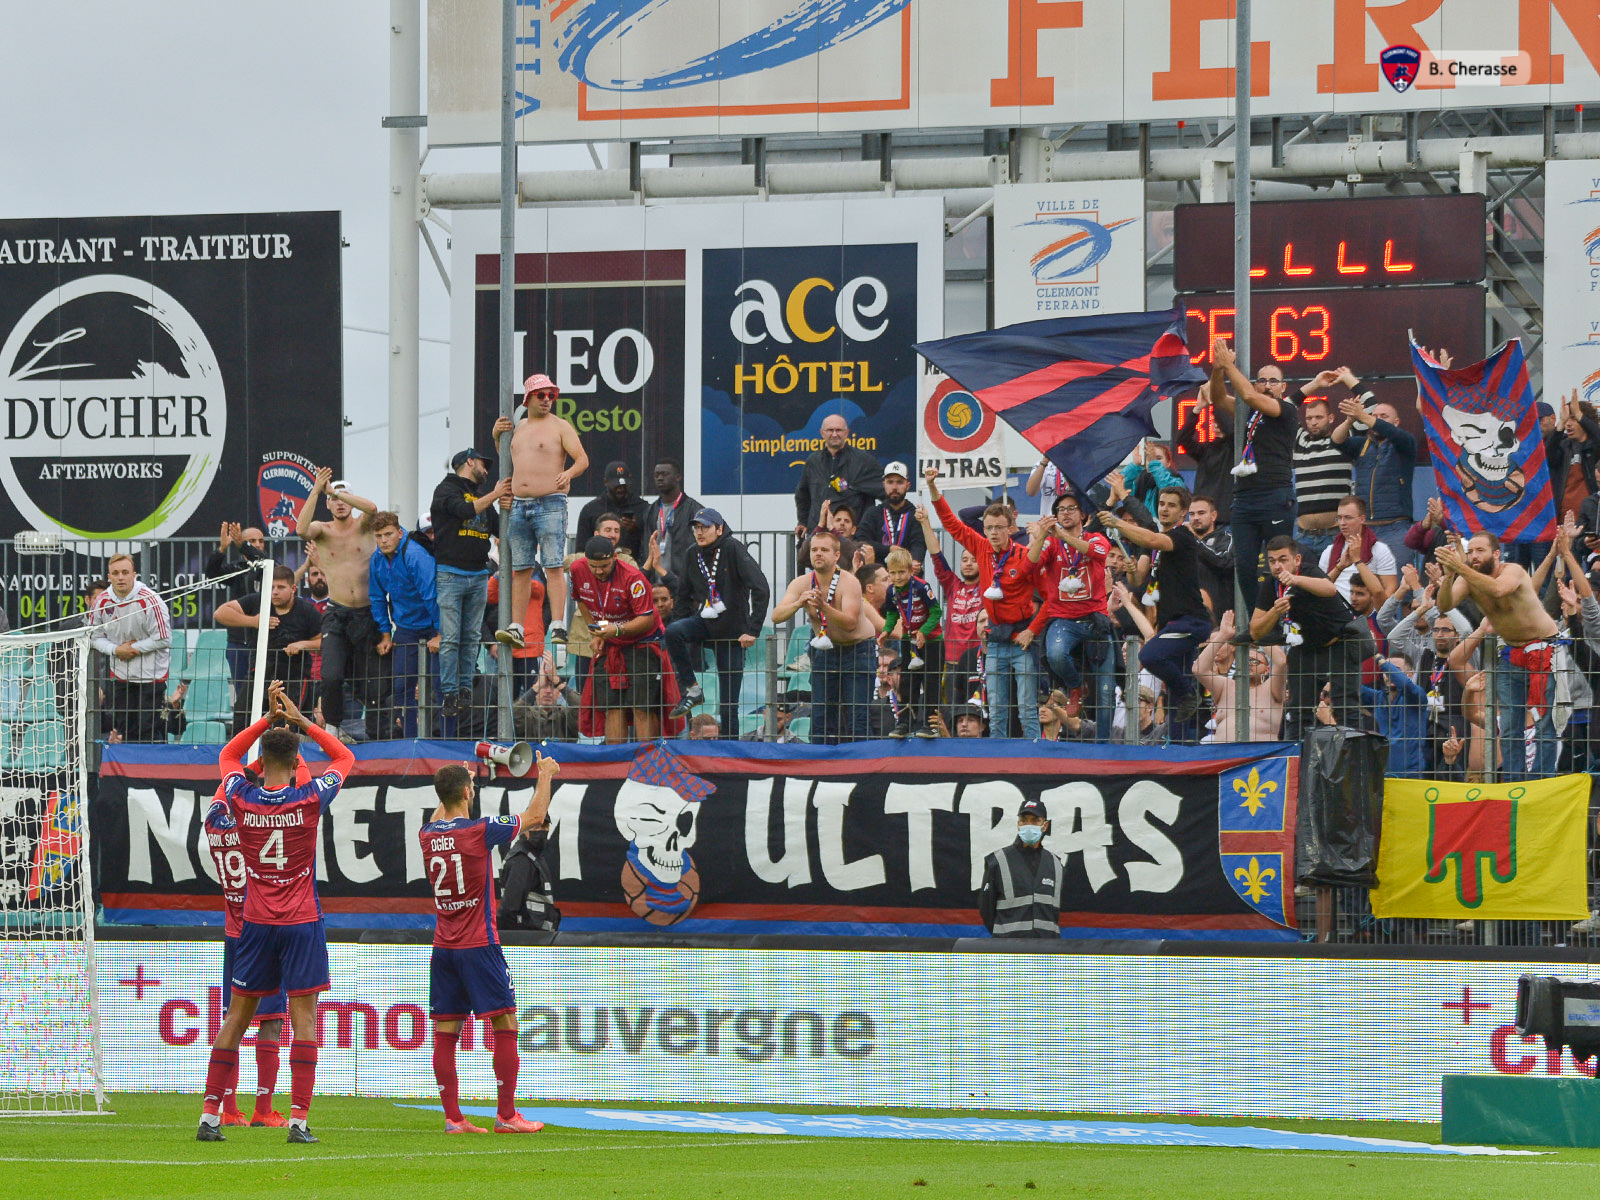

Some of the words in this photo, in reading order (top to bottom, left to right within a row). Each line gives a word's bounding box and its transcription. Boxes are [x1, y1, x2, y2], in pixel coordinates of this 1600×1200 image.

[1037, 201, 1075, 211] VILLE
[1082, 200, 1099, 209] DE
[0, 237, 117, 265] AURANT
[140, 234, 292, 262] TRAITEUR
[1036, 287, 1100, 298] CLERMONT
[729, 276, 889, 346] ace
[1037, 300, 1100, 311] FERRAND
[1270, 306, 1330, 362] 63
[735, 354, 883, 394] HÔTEL
[4, 395, 211, 440] DUCHER
[555, 398, 642, 436] Resto
[742, 434, 828, 457] simplemen
[39, 463, 163, 480] AFTERWORKS
[262, 468, 299, 480] CLERMONT
[918, 457, 1002, 479] ULTRAS
[270, 526, 285, 537] 63
[20, 595, 47, 618] 04
[243, 809, 304, 828] HOUNTONDJI
[431, 836, 455, 852] OGIER
[745, 777, 1183, 894] ULTRAS
[259, 830, 288, 870] 4
[214, 850, 247, 889] 19
[430, 854, 466, 896] 21
